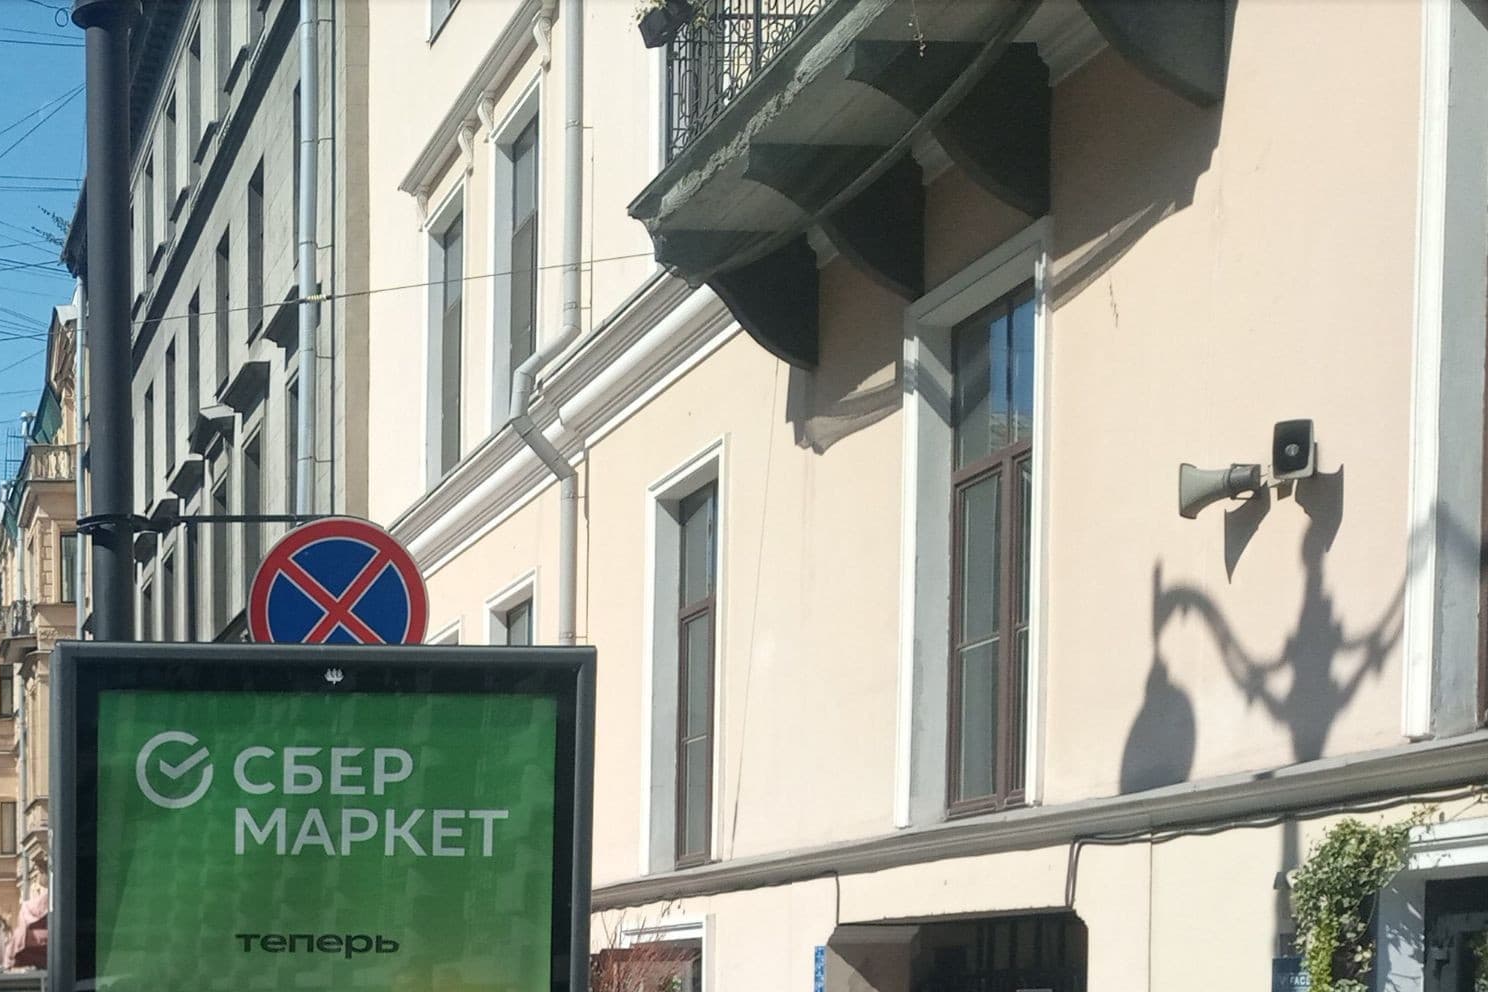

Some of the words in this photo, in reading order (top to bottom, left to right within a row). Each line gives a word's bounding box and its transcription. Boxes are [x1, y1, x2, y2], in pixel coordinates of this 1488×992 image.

[233, 745, 413, 796] СБЕР
[234, 808, 510, 857] МАРКЕТ
[235, 932, 400, 959] теперь
